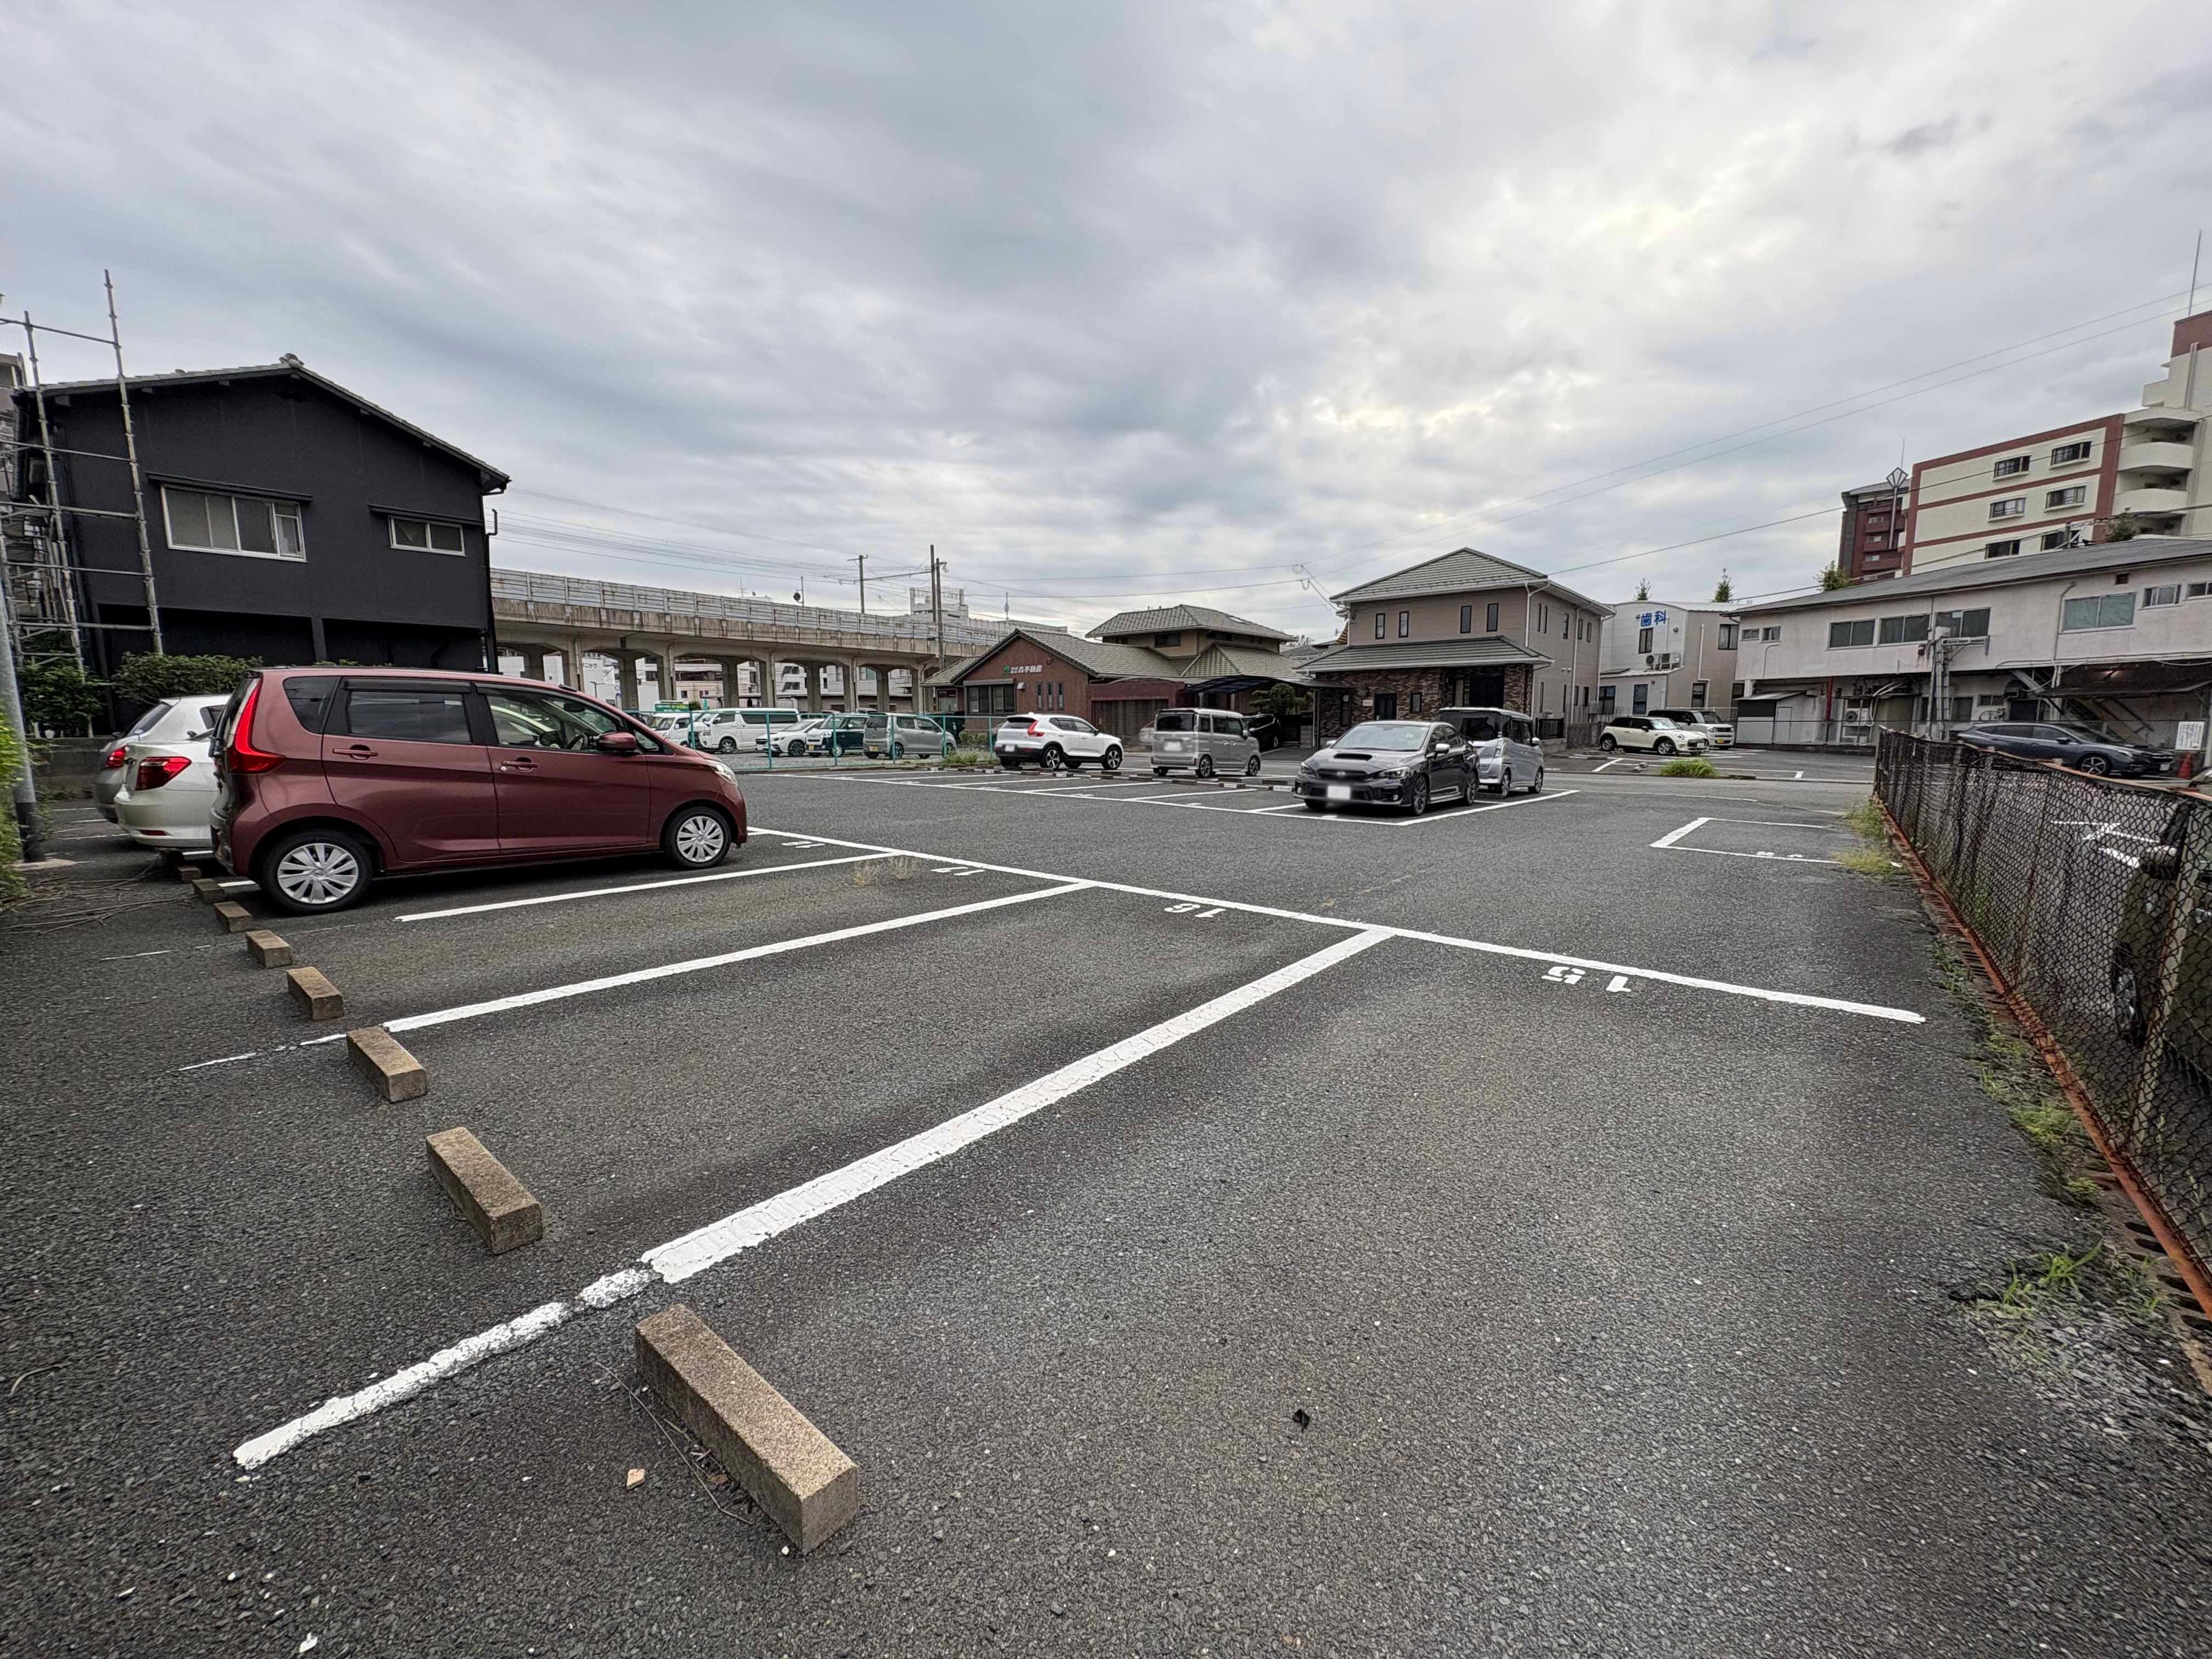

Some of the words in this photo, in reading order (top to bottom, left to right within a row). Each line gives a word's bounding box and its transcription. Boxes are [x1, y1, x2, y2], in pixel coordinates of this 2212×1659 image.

[1641, 609, 1667, 627] 歯科
[930, 866, 986, 876] 17
[1164, 903, 1226, 918] 16
[1541, 966, 1631, 993] 15
